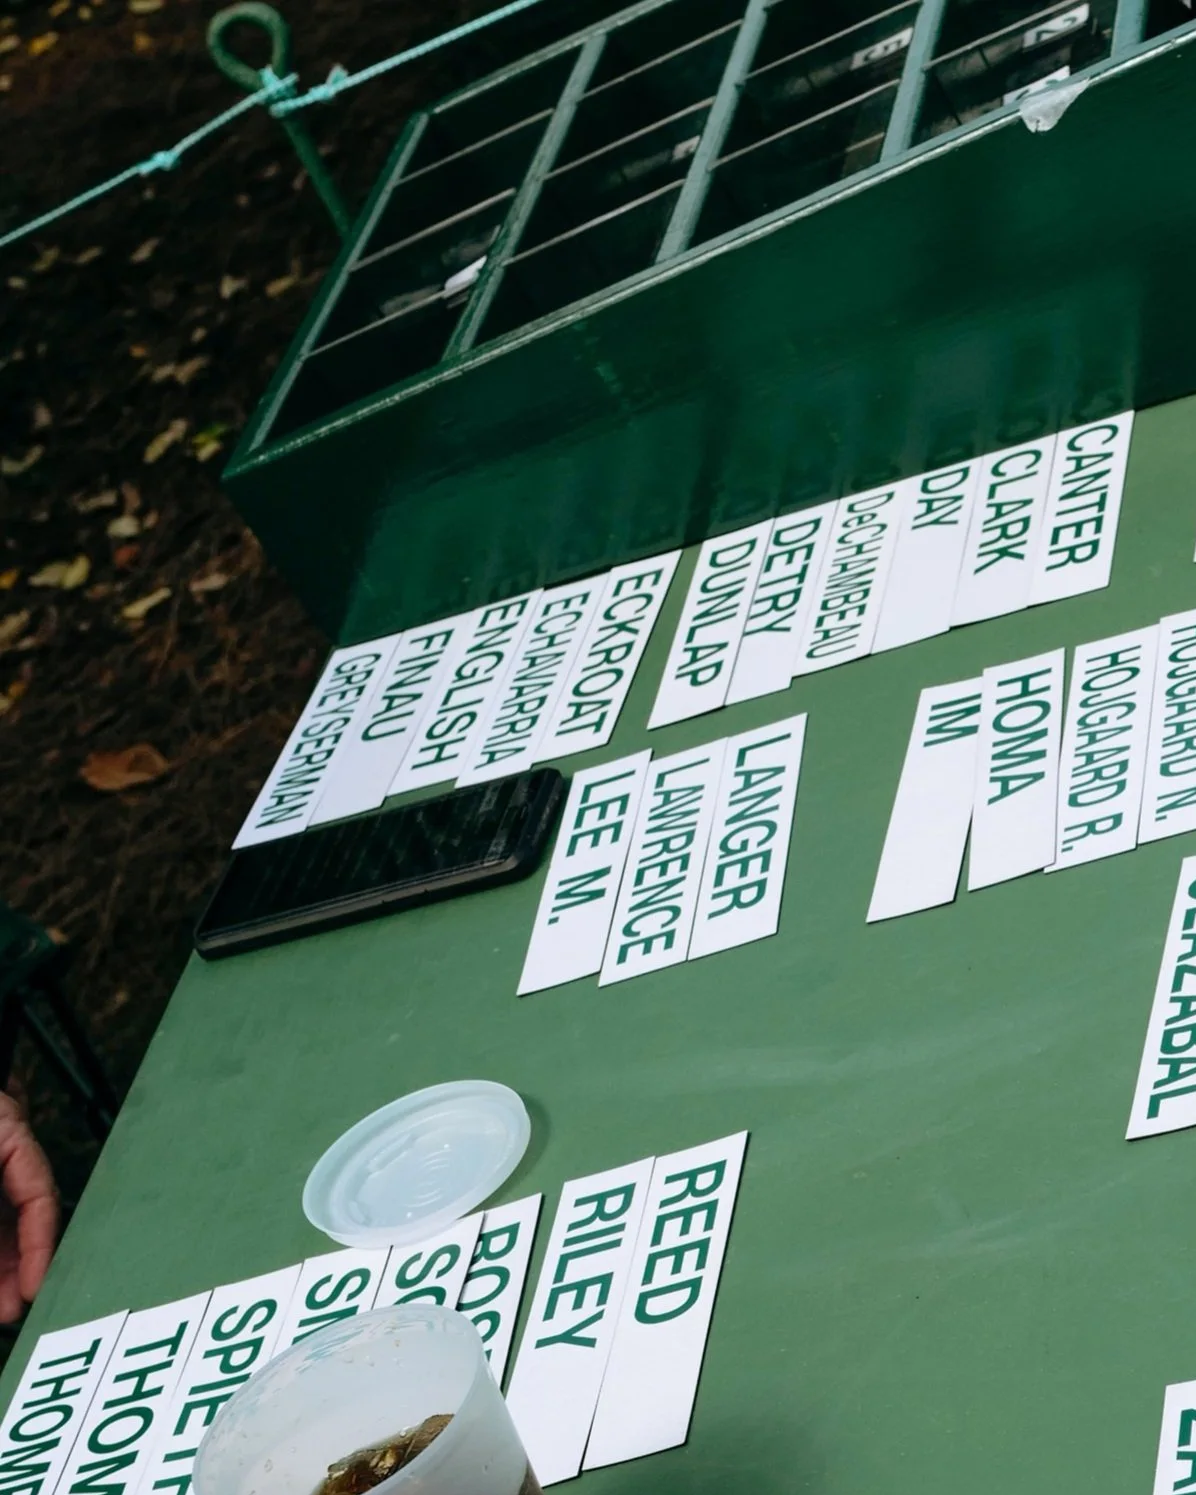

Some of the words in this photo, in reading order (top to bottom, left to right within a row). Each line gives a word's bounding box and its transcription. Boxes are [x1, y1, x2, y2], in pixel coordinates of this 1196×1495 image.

[912, 467, 969, 529] DAY
[975, 450, 1041, 573] CLARK
[1047, 425, 1118, 570] CANTER
[676, 547, 754, 688] DUNLAP
[743, 518, 821, 636] DETRY
[807, 492, 894, 658] DeCHAMBEAU
[362, 634, 452, 744] FINAU
[411, 605, 525, 772] ENGLISH
[474, 591, 591, 771] ECHAVARRIA
[556, 574, 659, 735] ECKROAT
[924, 694, 981, 746] IM
[256, 654, 381, 828] GREYSERMAN
[989, 669, 1051, 804] HOMA
[1069, 650, 1141, 810] HOJGAARD
[566, 772, 630, 858] LEE
[616, 757, 709, 957] LAWRENCE
[709, 734, 790, 918] LANGER
[1059, 814, 1116, 853] R.
[548, 872, 606, 927] M.
[536, 1184, 635, 1348] RILEY
[635, 1160, 726, 1323] REED
